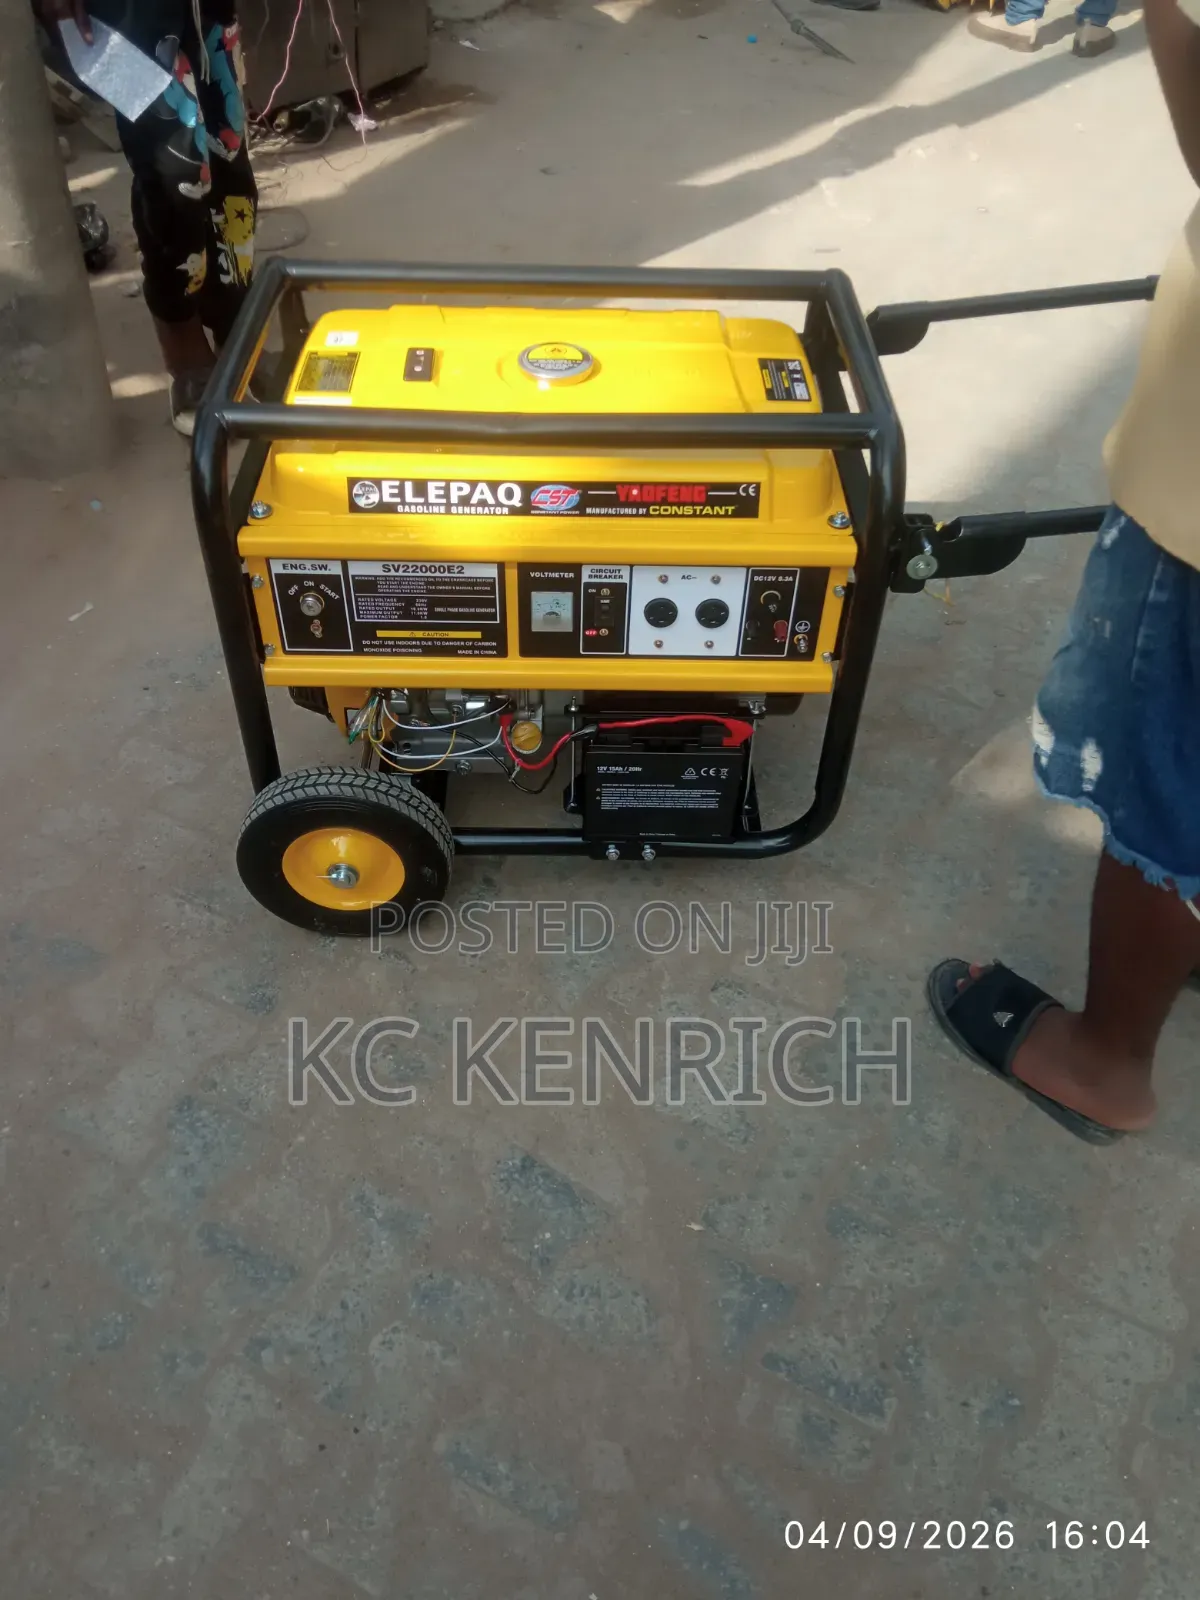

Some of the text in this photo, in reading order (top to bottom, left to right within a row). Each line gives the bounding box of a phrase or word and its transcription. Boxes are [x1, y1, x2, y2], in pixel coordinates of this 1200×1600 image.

[381, 480, 523, 507] ELEPAQ
[616, 484, 706, 502] YAOFENG
[739, 484, 757, 496] CE
[531, 489, 579, 506] CST
[398, 504, 509, 515] GASOLINE GENERATOR
[649, 506, 736, 515] CONSTANT
[282, 563, 332, 572] ENG.SW.
[382, 564, 465, 575] SV22000E2
[288, 584, 299, 596] OFF
[319, 584, 340, 600] START
